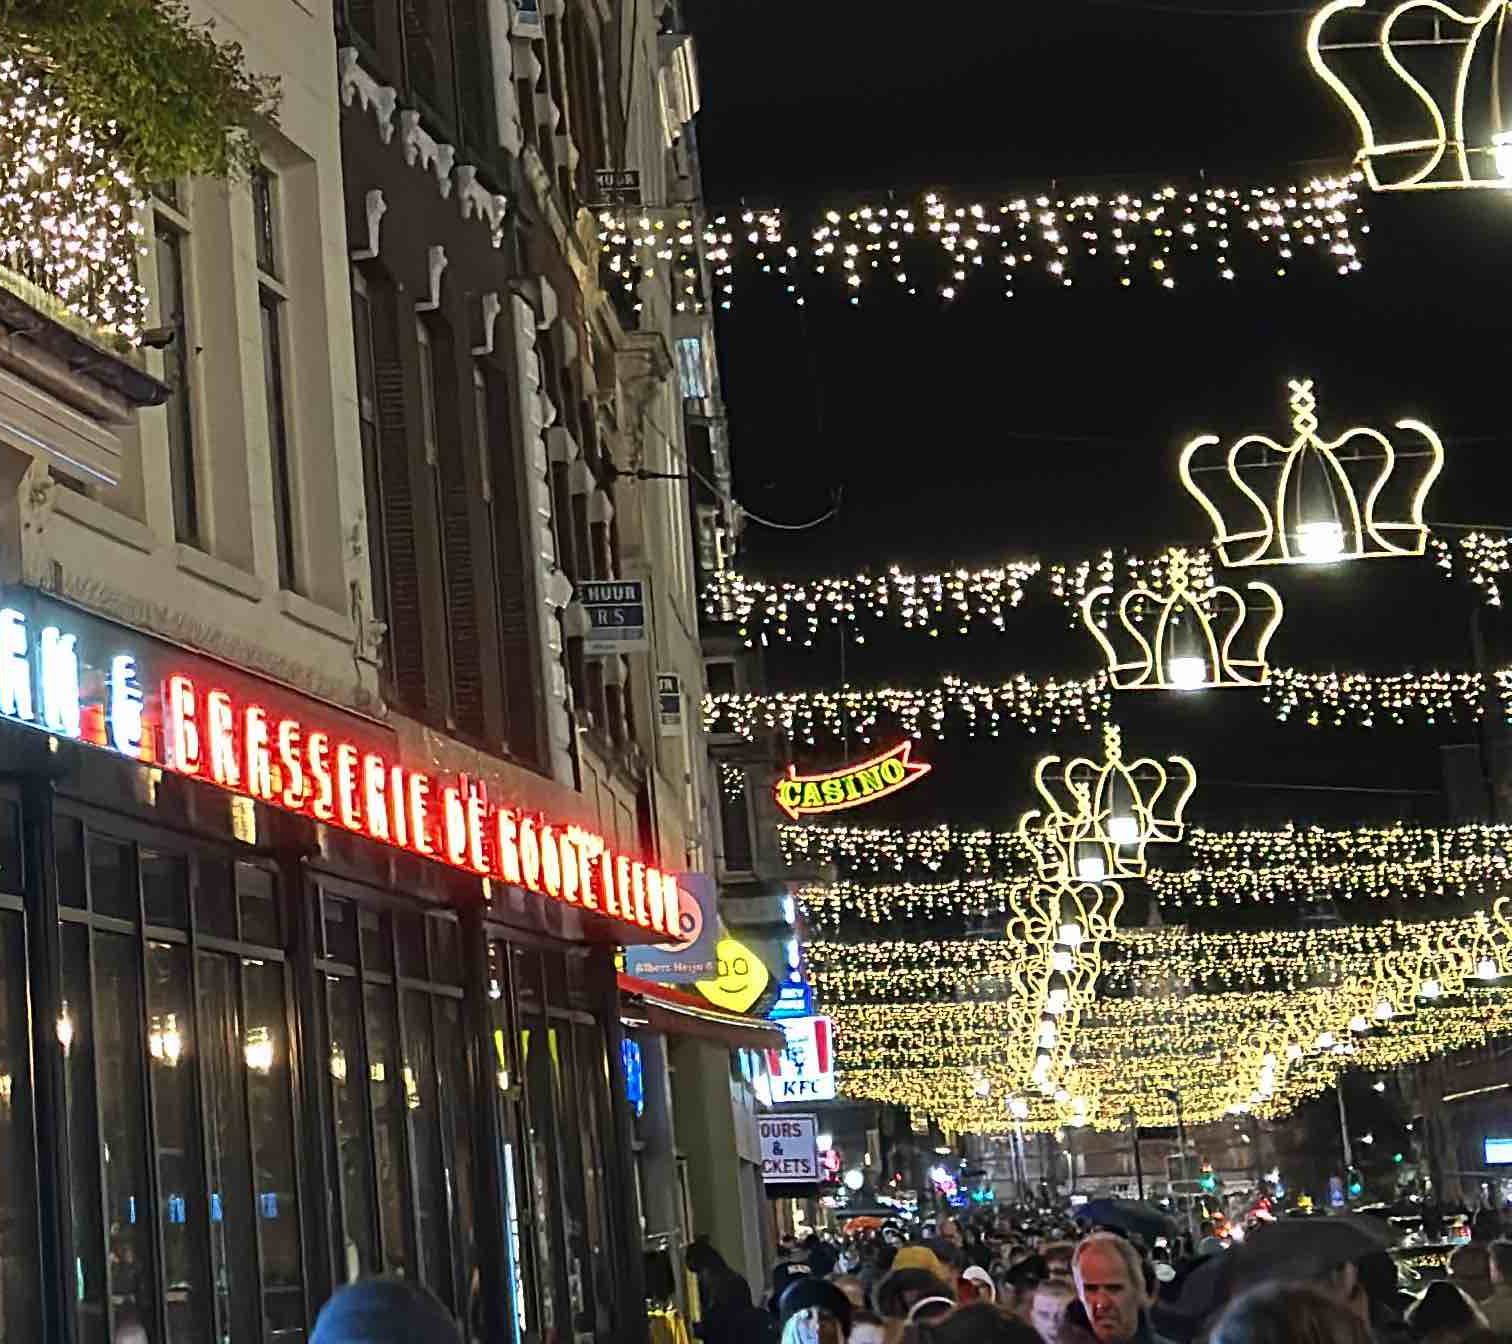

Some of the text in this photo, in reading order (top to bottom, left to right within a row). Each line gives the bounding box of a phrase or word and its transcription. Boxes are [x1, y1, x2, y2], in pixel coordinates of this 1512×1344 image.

[587, 584, 636, 602] HUUR
[597, 608, 625, 625] RS
[169, 674, 435, 854] BRASSERIE
[443, 786, 491, 874] DE
[780, 757, 906, 808] CASINO
[783, 1078, 821, 1097] KFC
[760, 1122, 802, 1138] OURS
[772, 1139, 785, 1156] &
[760, 1158, 810, 1174] CKETS
